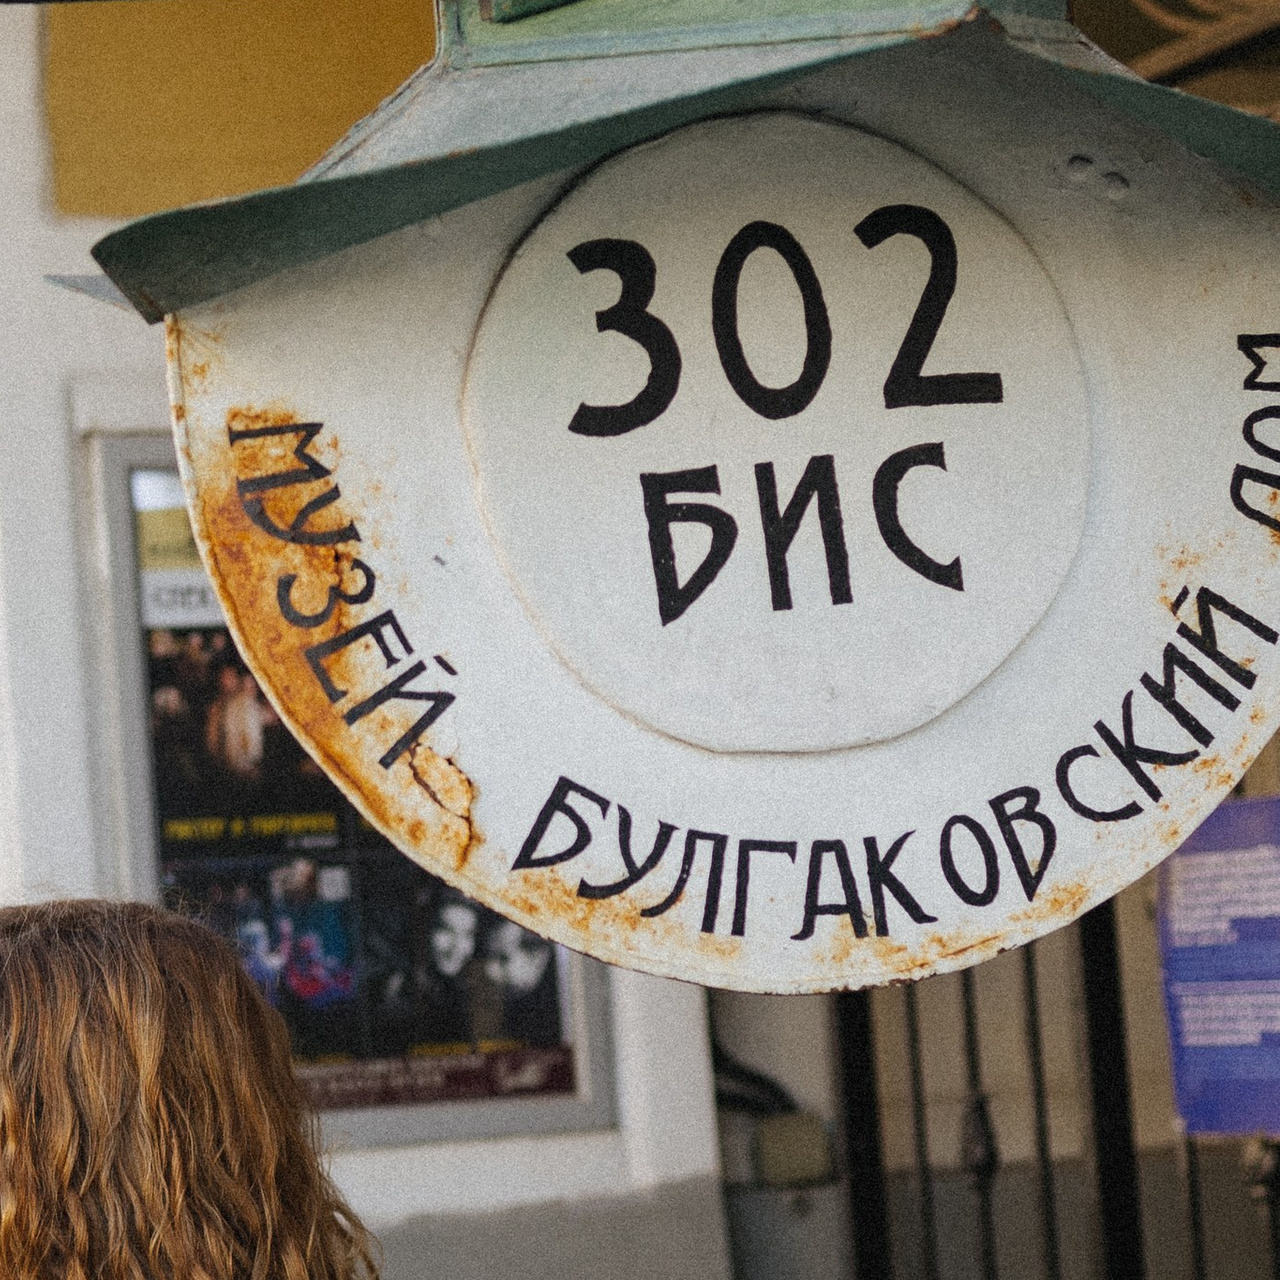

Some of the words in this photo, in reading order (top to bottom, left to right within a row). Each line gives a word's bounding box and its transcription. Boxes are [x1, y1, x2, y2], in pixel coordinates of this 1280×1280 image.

[564, 204, 1004, 438] 302
[639, 440, 965, 627] БИС
[227, 421, 459, 770] МУЗЕЙ
[510, 584, 1280, 942] БУЛГАКОВСКИЙ
